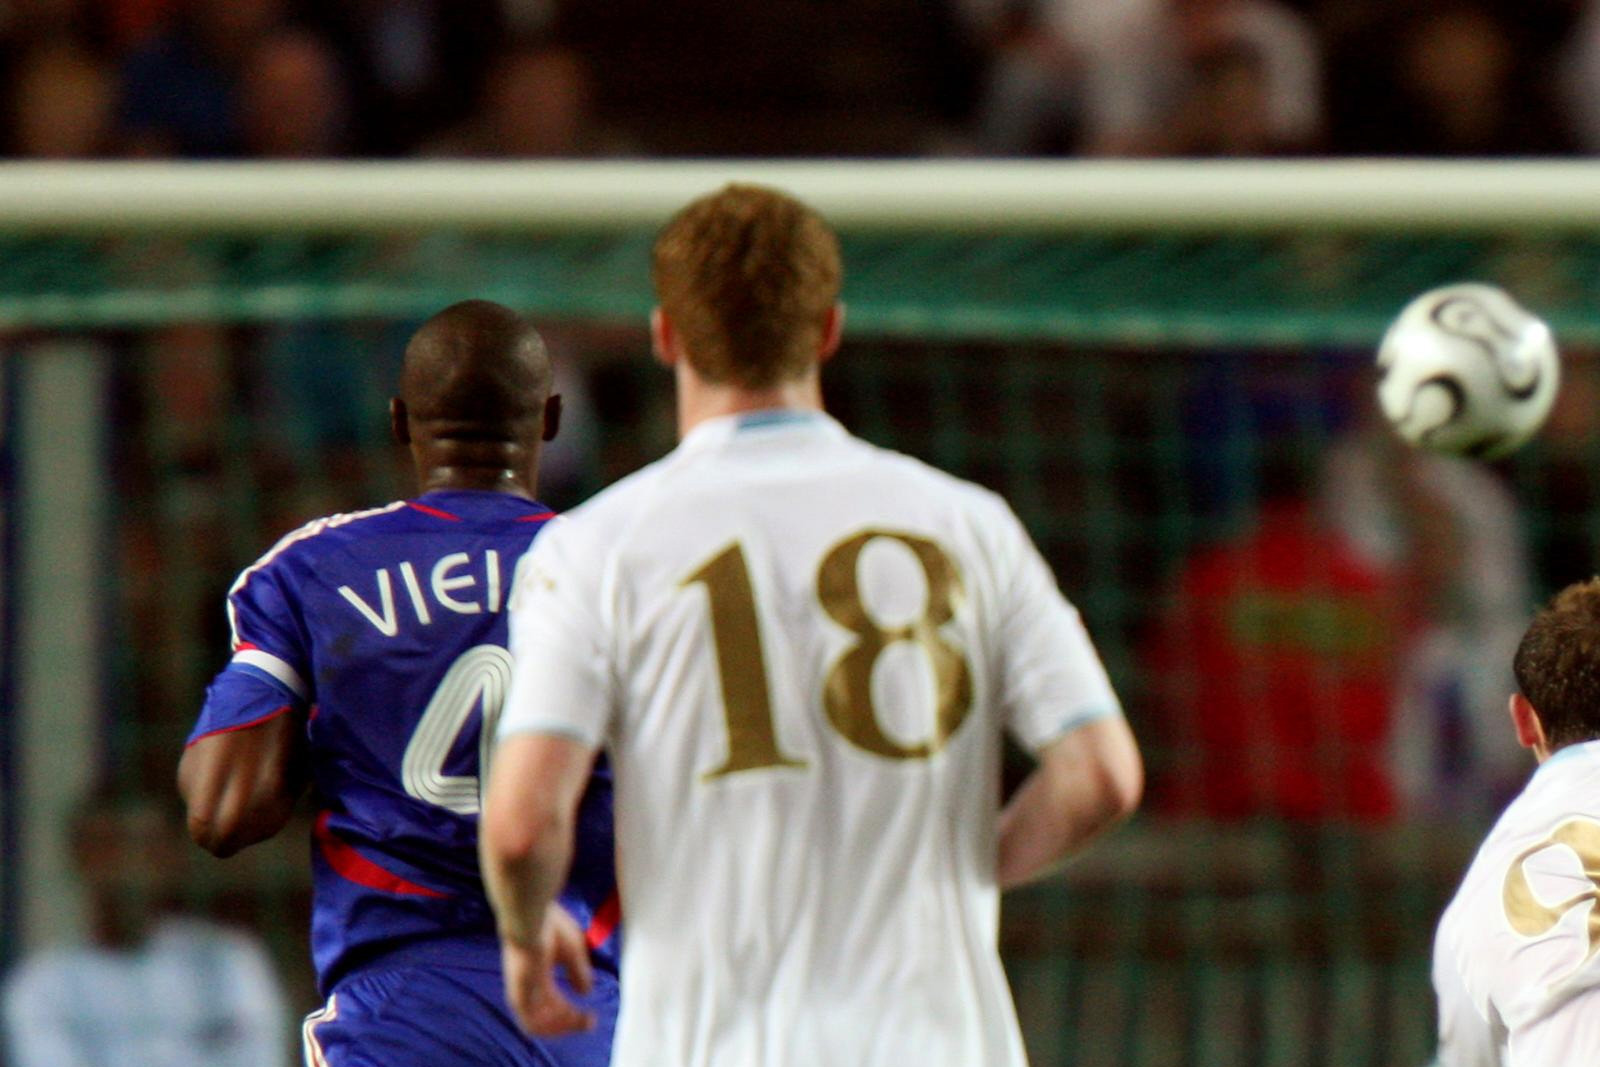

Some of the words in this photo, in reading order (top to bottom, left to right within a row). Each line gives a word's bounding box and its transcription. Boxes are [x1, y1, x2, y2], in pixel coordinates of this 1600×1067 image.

[338, 549, 516, 637] VIEI
[676, 524, 974, 781] 18
[402, 644, 515, 815] 4
